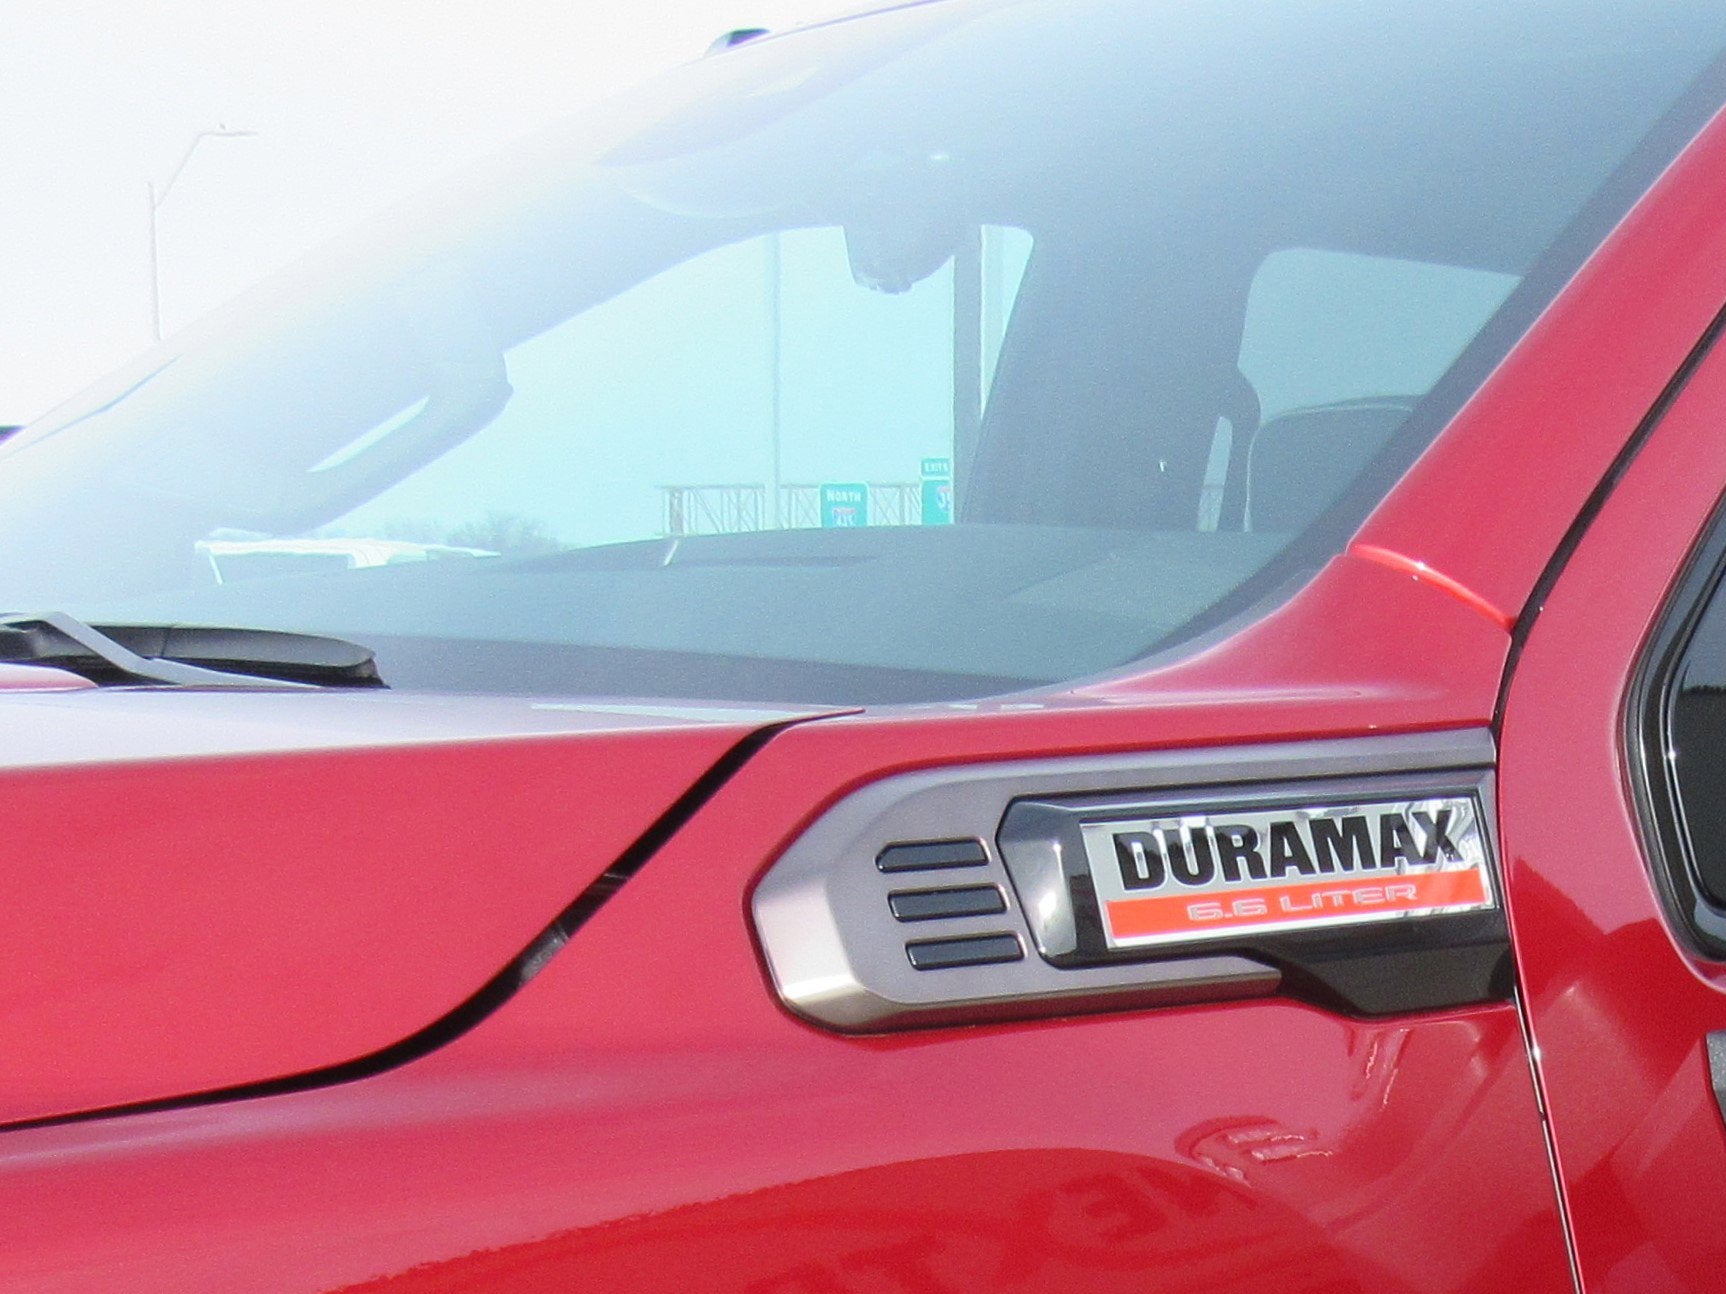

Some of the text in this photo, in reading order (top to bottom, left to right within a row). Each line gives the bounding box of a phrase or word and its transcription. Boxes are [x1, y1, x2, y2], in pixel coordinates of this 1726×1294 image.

[826, 489, 862, 503] NORTH
[1112, 811, 1465, 892] DURAMAX
[1187, 883, 1419, 922] 6.6 LITER
